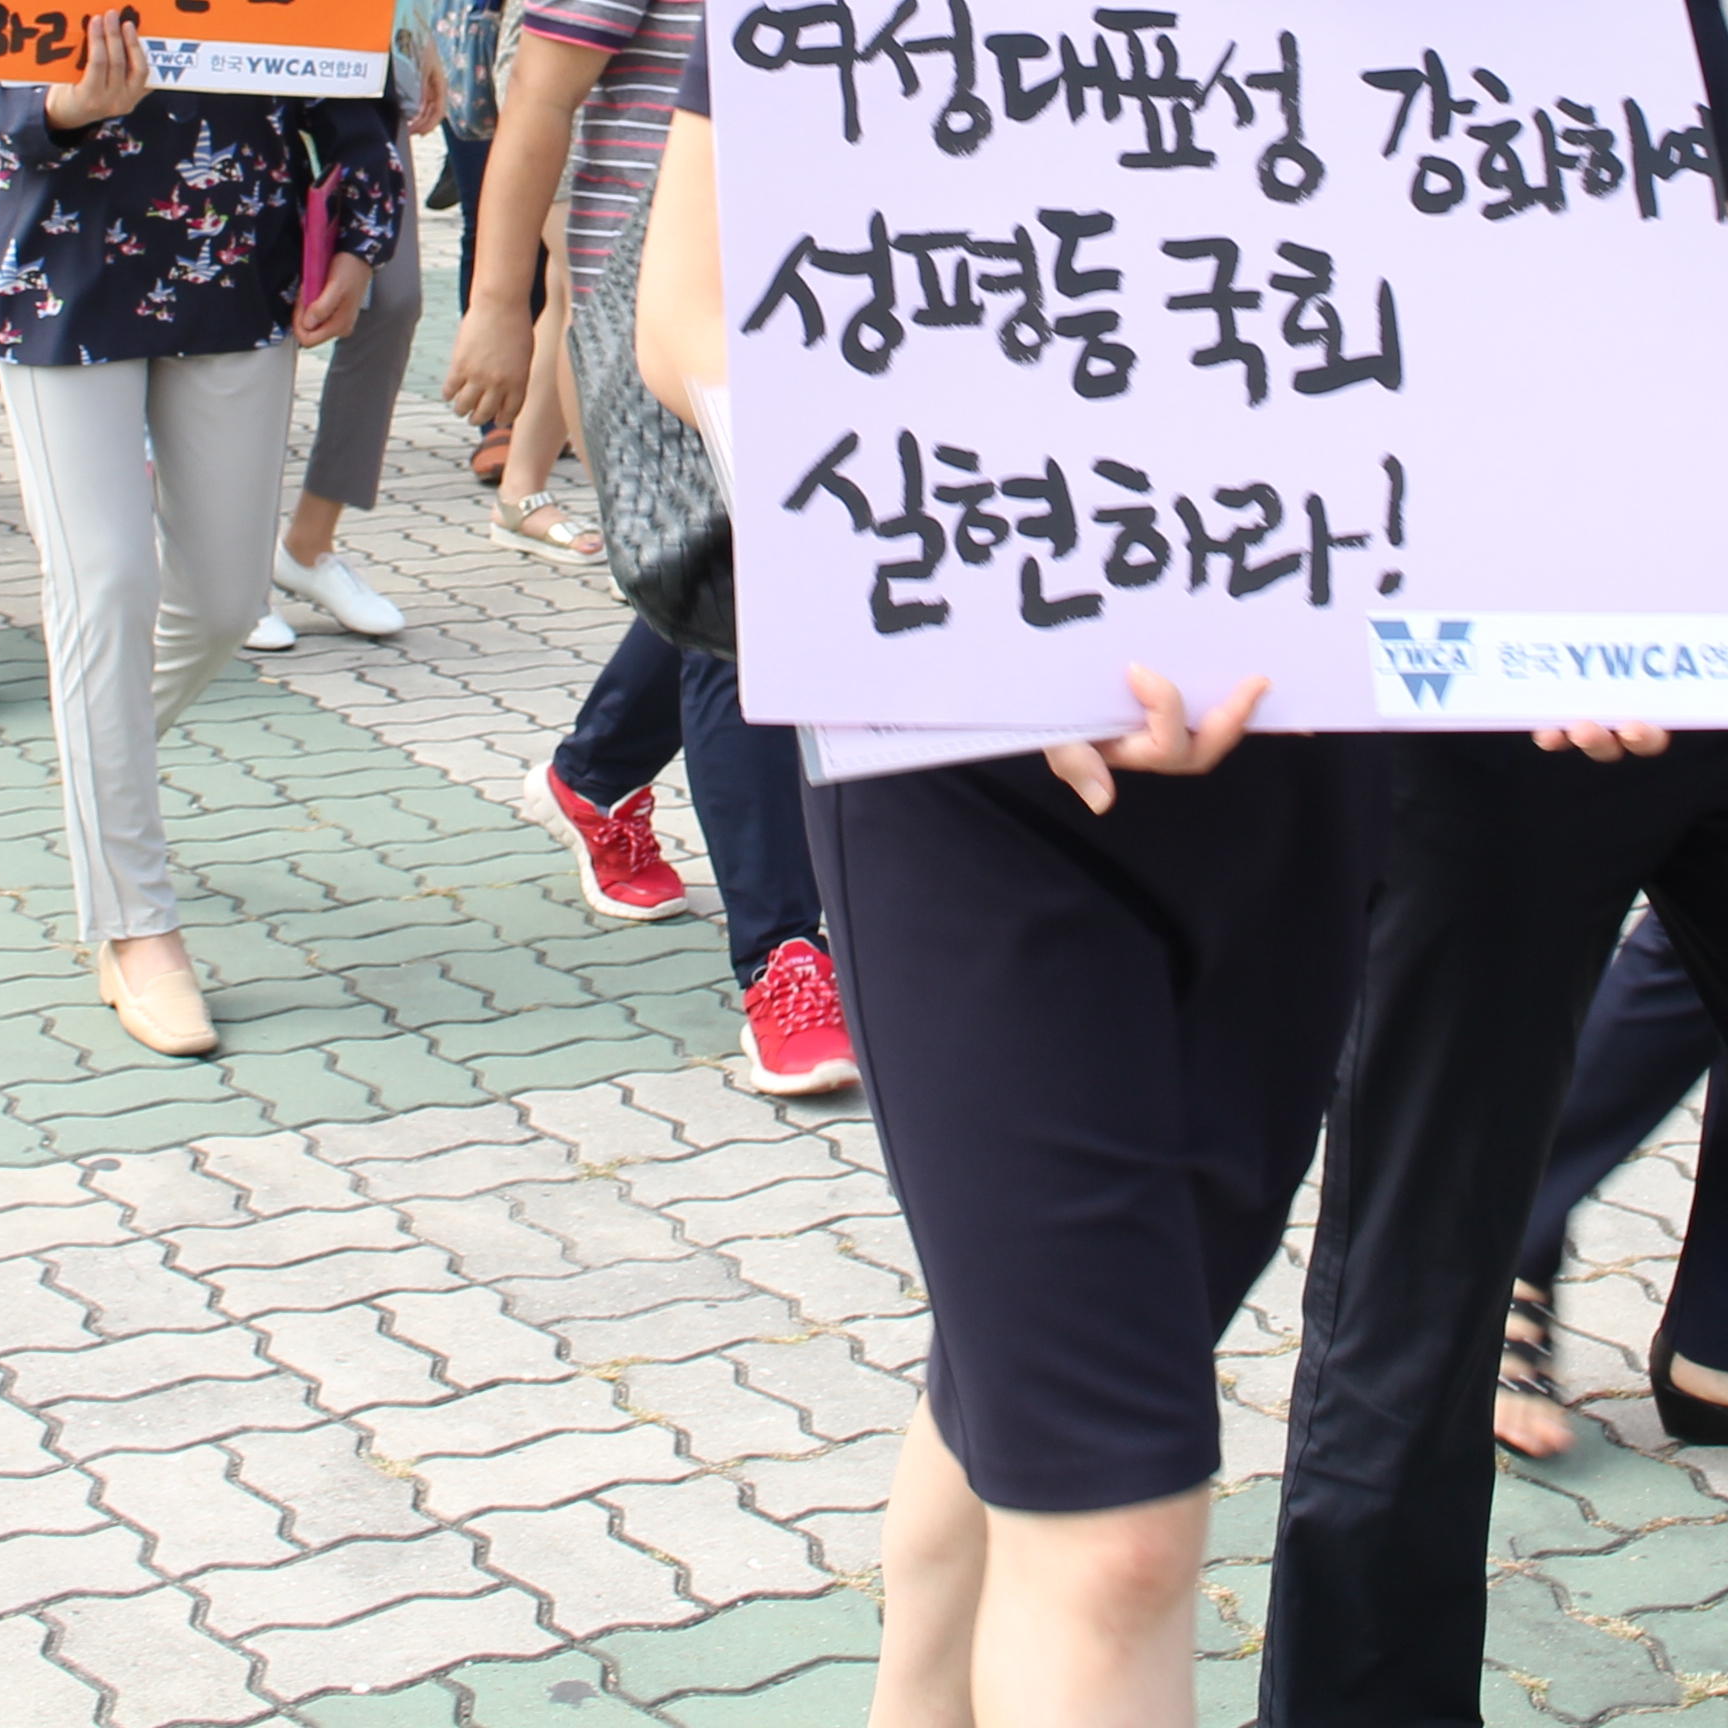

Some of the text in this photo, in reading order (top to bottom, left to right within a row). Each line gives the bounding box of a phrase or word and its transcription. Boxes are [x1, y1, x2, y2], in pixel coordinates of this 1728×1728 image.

[149, 53, 195, 67] YWCA
[1361, 48, 1728, 221] 강화하여
[783, 431, 1407, 634] 실현하라!
[1380, 644, 1468, 669] YWCA
